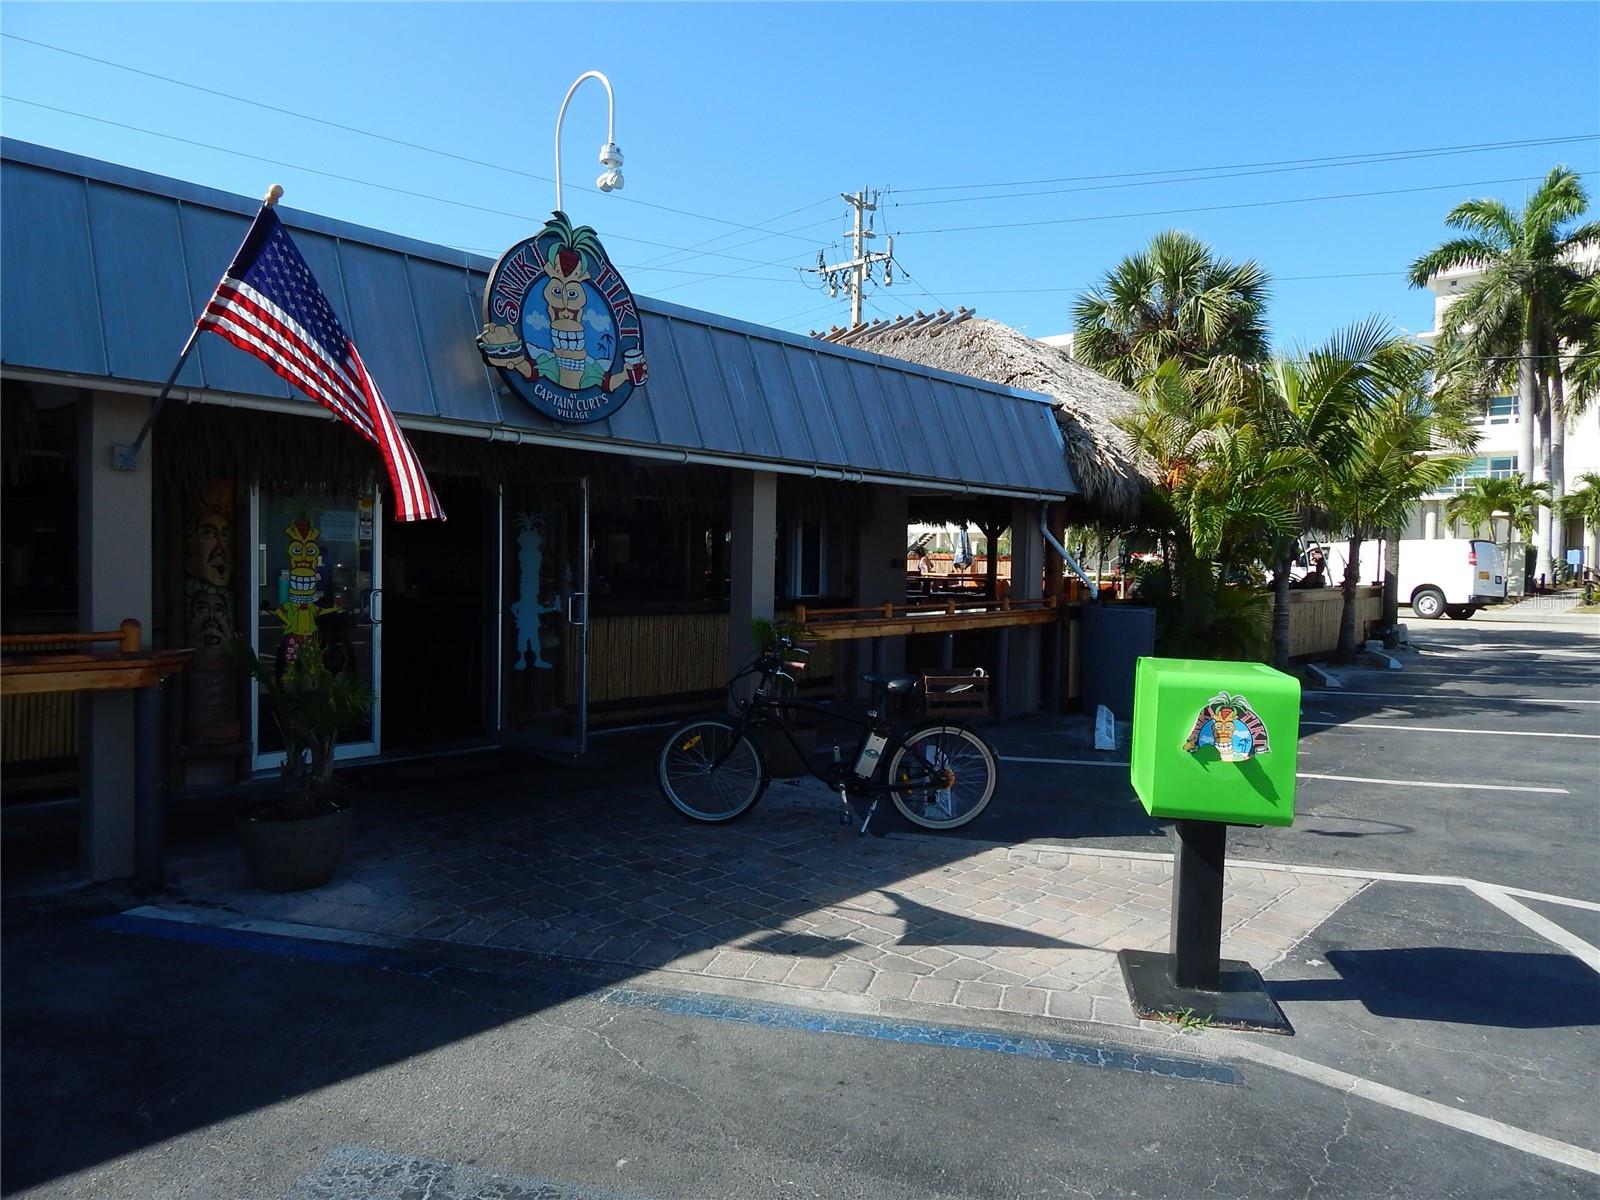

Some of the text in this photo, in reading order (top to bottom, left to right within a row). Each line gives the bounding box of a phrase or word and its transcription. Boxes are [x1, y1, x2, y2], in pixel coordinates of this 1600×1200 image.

[493, 241, 640, 341] SNIKI TIKI
[534, 384, 609, 411] CAPTAIN CURT'S
[557, 408, 590, 419] VILLAGE
